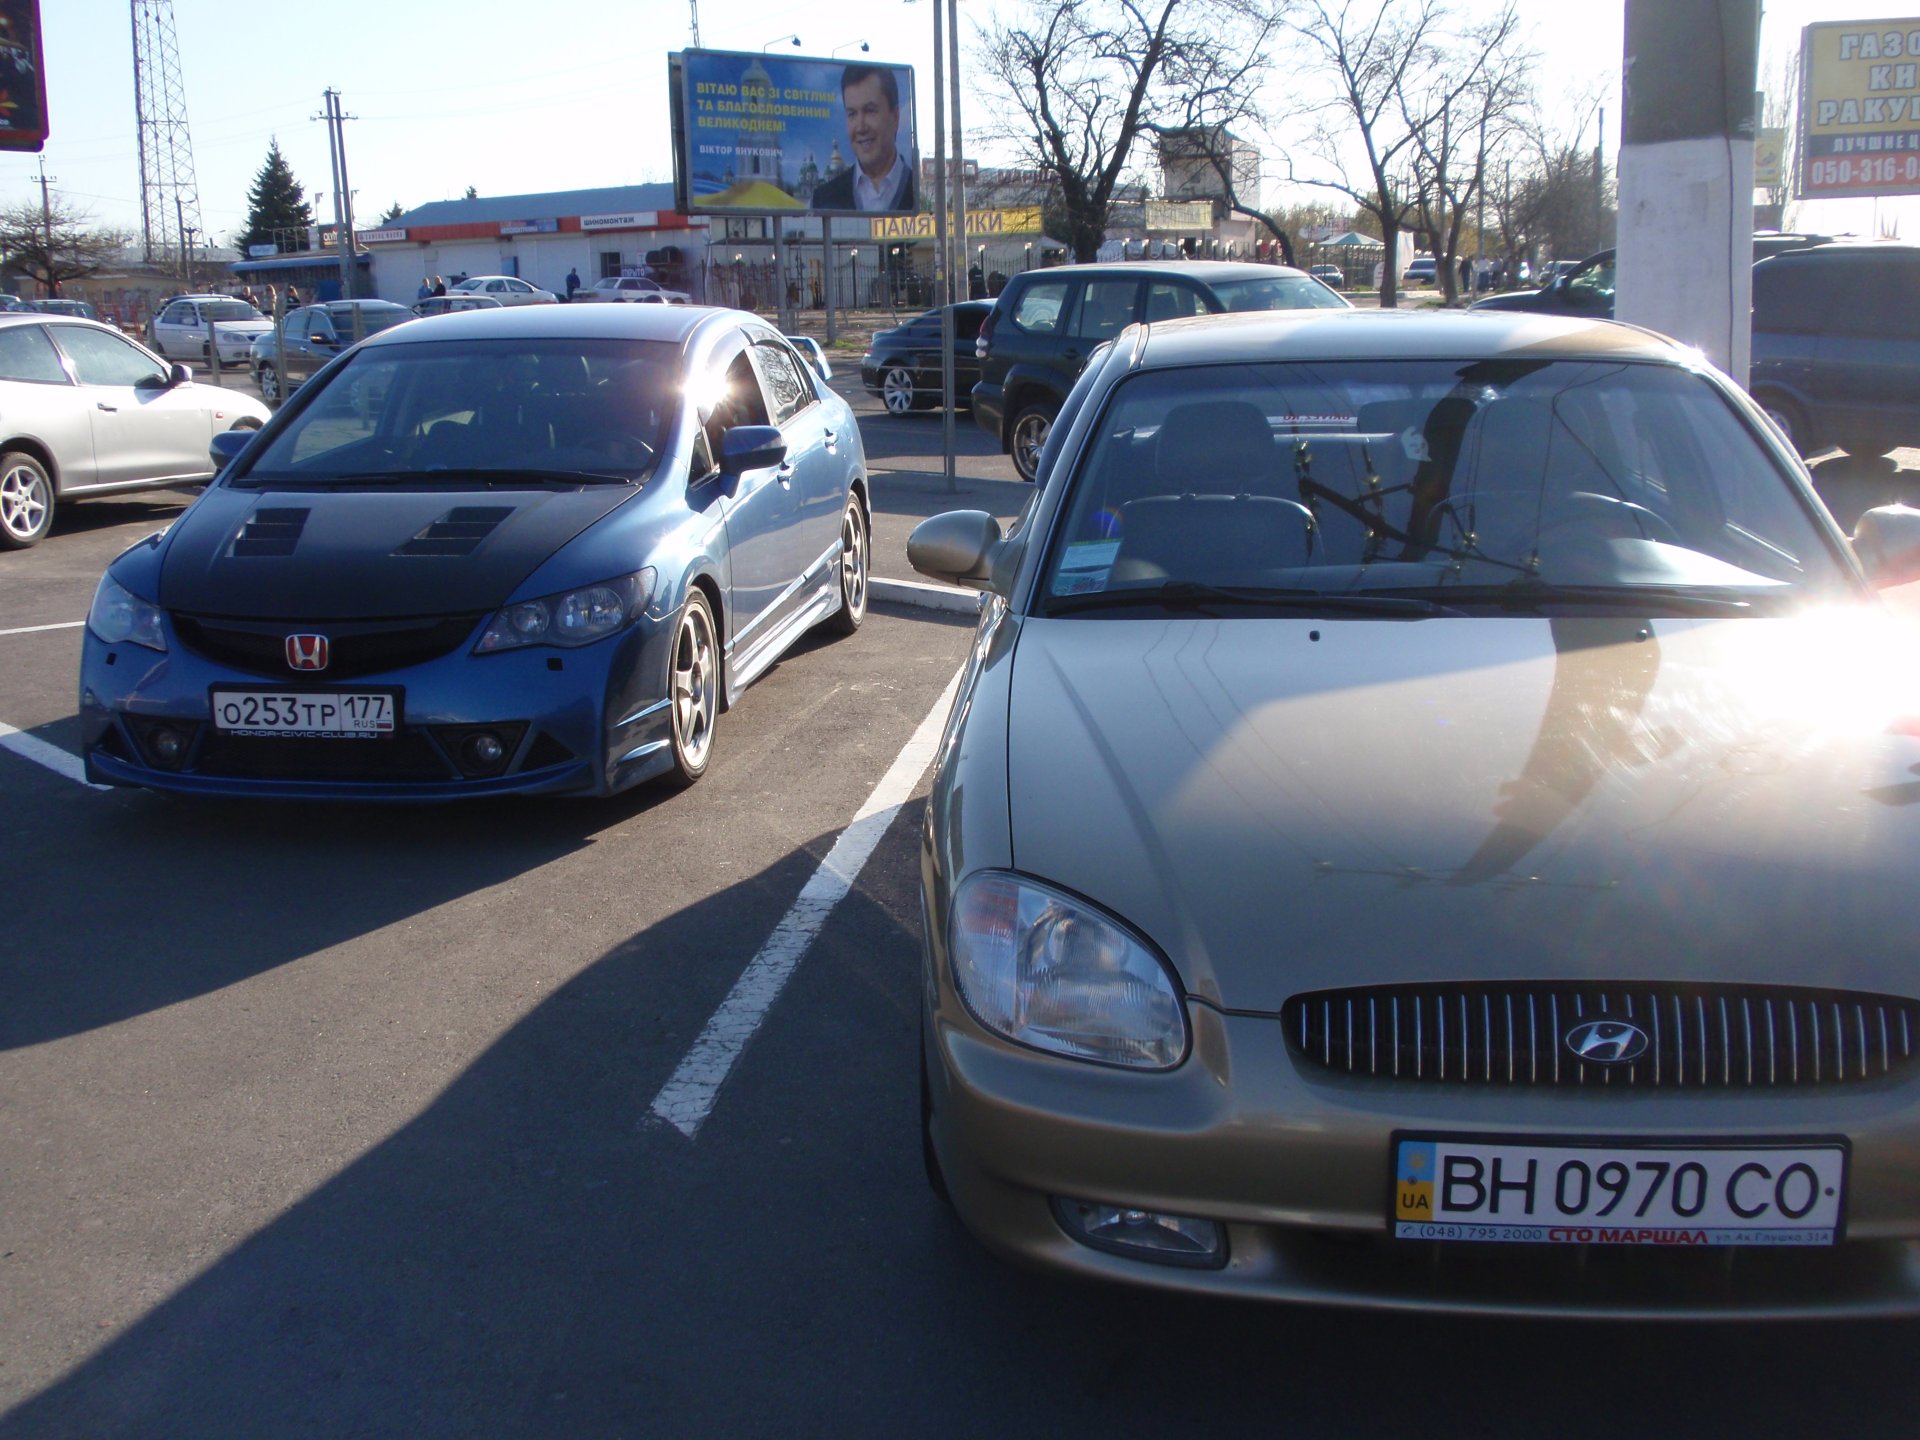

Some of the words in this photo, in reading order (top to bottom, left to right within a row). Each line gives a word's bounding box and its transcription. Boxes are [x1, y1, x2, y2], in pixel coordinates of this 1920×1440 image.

[1869, 63, 1920, 92] КИ
[697, 83, 737, 95] ВІТАЮ
[741, 86, 765, 98] ВАС
[768, 89, 780, 99] ЗІ
[784, 90, 836, 103] СВІТЛИМ
[697, 100, 713, 111] ТА
[717, 101, 830, 118] БЛАГОСЛОВЕННИМ
[698, 117, 786, 132] ВЕЛИКОДНЕМ!
[699, 145, 733, 155] ВІКТОР
[735, 147, 783, 158] ЯНУКОВИЧ
[1833, 136, 1904, 152] ЛУЧШИЕ
[1811, 156, 1920, 184] 050-316-0
[873, 212, 1003, 236] ПАМЯНИКИ
[343, 695, 386, 720] 177
[353, 719, 376, 729] RUS
[1554, 1158, 1709, 1219] 0970
[1402, 1193, 1430, 1209] UA
[1419, 1224, 1462, 1239] (048)
[1468, 1226, 1497, 1239] 795
[1502, 1226, 1542, 1240] 2000
[1548, 1228, 1593, 1243] СТО
[1598, 1229, 1708, 1244] МАРШАЛ
